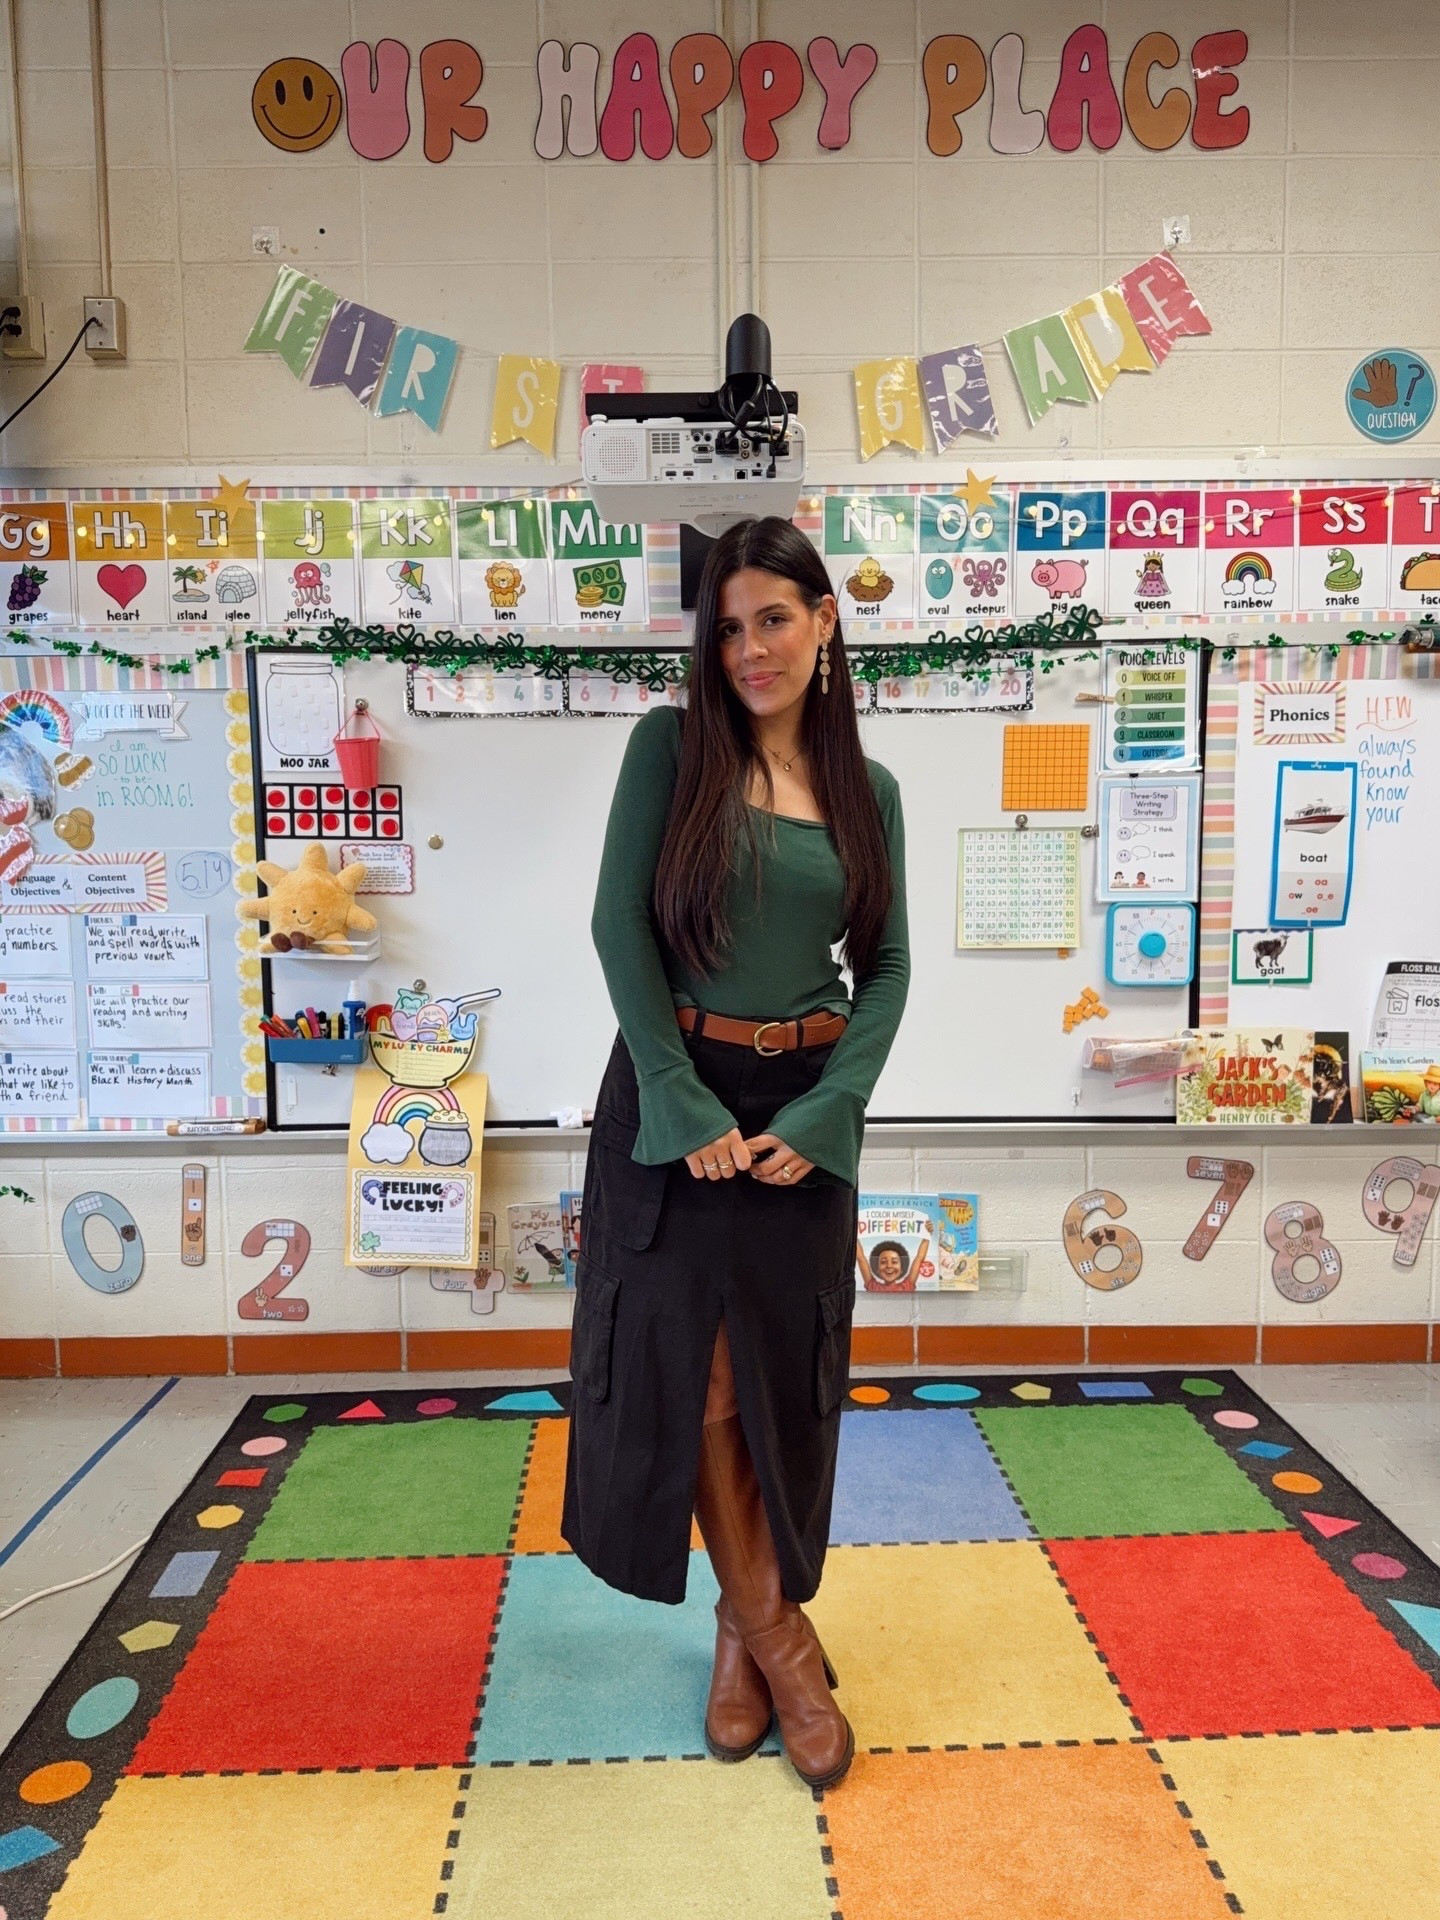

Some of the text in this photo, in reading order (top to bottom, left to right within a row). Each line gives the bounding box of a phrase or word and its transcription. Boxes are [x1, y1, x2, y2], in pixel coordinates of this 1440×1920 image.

[534, 32, 878, 161] HAPPY
[922, 24, 1250, 157] PLACE
[875, 273, 1184, 432] GRADE
[1366, 410, 1417, 430] QUESTION
[1126, 499, 1185, 544] Qq
[1225, 498, 1274, 537] Rr
[1322, 496, 1366, 534] Ss
[194, 508, 229, 548] Ii
[379, 507, 433, 547] Kk
[486, 508, 518, 547] Ll
[558, 508, 638, 547] Mm
[843, 505, 897, 542] Nn
[936, 503, 994, 542] Oo
[1035, 500, 1088, 547] Pp
[0, 511, 52, 558] Gg
[92, 510, 148, 549] Hh
[293, 508, 325, 555] Jj
[1134, 598, 1171, 613] queen
[1224, 597, 1273, 609] rainbow
[1325, 594, 1359, 606] snake
[177, 609, 207, 620] island
[398, 607, 422, 619] kite
[856, 603, 881, 616] nest
[927, 604, 950, 615] oval
[965, 604, 1006, 617] octopus
[1051, 602, 1068, 614] pig
[8, 610, 49, 624] grapes
[106, 609, 140, 621] heart
[224, 608, 251, 623] igloo
[283, 608, 336, 622] jellyfish
[494, 609, 516, 621] lion
[580, 610, 621, 622] money
[1119, 651, 1185, 666] VOICE LEVELS
[1142, 672, 1176, 681] VOICE OFF
[485, 685, 554, 702] 3 4 5
[580, 685, 649, 703] 6 7 8
[884, 682, 901, 699] 16
[914, 681, 930, 698] 17
[943, 681, 960, 697] 18
[972, 680, 990, 697] 19
[1000, 678, 1022, 696] 20
[1145, 692, 1173, 702] WHISPER
[113, 704, 125, 719] OF
[130, 704, 145, 719] THE
[147, 704, 174, 719] WEEK
[1147, 711, 1166, 721] QUIET
[1269, 708, 1330, 722] Phonics
[1137, 730, 1175, 739] CLASSROOM
[1358, 734, 1417, 761] always
[98, 750, 167, 777] SO LUCKY
[280, 758, 330, 768] MOO JAR
[1359, 759, 1415, 779] found
[96, 785, 115, 807] in
[178, 782, 194, 808] 6!
[1130, 792, 1169, 801] Three-Step
[1136, 801, 1162, 809] Writing
[1133, 808, 1164, 817] Strategy
[1366, 805, 1405, 831] your
[1300, 853, 1328, 863] boat
[16, 874, 56, 884] anguage
[88, 873, 127, 882] Content
[10, 887, 61, 897] Objectives
[85, 886, 136, 897] Objectives
[1288, 892, 1303, 900] ow
[5, 923, 53, 940] practice
[88, 926, 127, 937] We will
[88, 936, 200, 949] and words with
[95, 951, 138, 964] previous
[1260, 966, 1285, 977] goat
[1400, 964, 1440, 973] FLOSS RUL
[4, 992, 67, 1004] read stories
[110, 995, 168, 1008] will practice
[25, 1005, 42, 1016] the
[93, 1007, 188, 1020] reading and writing
[14, 1017, 64, 1026] and their
[373, 1040, 469, 1054] MY LUKY CHARMS
[1372, 1057, 1387, 1065] This
[1407, 1056, 1434, 1064] Garden
[8, 1063, 69, 1077] write about
[90, 1064, 201, 1075] We will learn discuss
[1216, 1056, 1279, 1081] JACK'S
[22, 1081, 35, 1089] we
[61, 1080, 74, 1090] to
[127, 1075, 163, 1089] History
[166, 1076, 193, 1086] Month
[29, 1089, 68, 1101] friend
[1207, 1083, 1287, 1108] GARDEN
[1219, 1113, 1276, 1124] HENRY COLE
[1194, 1168, 1225, 1180] seven
[382, 1181, 444, 1196] FEELING
[382, 1198, 444, 1213] LUCKY!
[1182, 1155, 1255, 1261] 7
[1362, 1156, 1440, 1267] 9
[530, 1209, 550, 1221] My
[892, 1211, 915, 1219] MYSELF
[858, 1219, 924, 1234] DIFFERENT
[62, 1191, 145, 1294] 0
[1063, 1189, 1143, 1291] 6
[183, 1253, 204, 1263] one
[1264, 1201, 1343, 1304] 8
[1394, 1250, 1414, 1262] nine
[237, 1218, 311, 1322] 2
[107, 1276, 133, 1292] zero
[443, 1279, 467, 1290] four
[1110, 1276, 1125, 1288] six
[1301, 1283, 1327, 1300] eight
[262, 1309, 283, 1319] two
